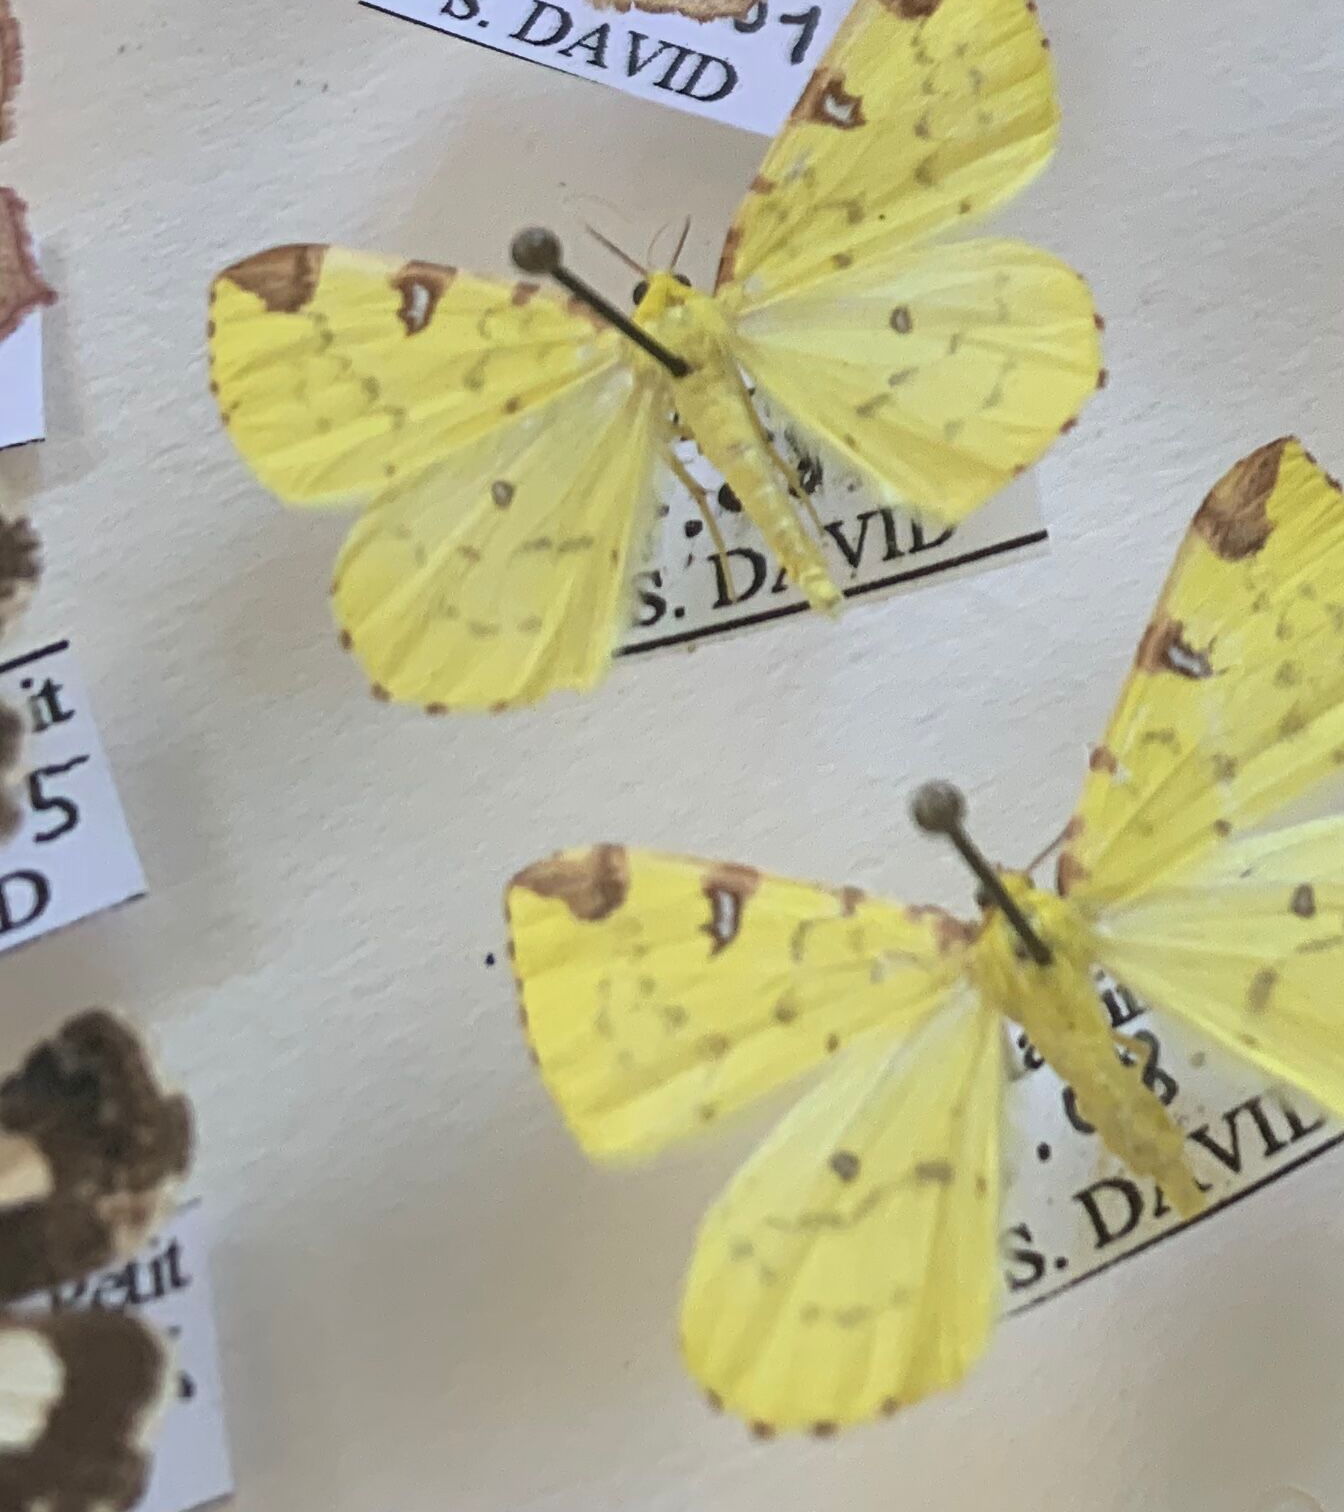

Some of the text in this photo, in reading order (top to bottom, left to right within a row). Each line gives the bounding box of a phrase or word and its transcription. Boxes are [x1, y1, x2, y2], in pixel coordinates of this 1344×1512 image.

[634, 503, 955, 627] S. DVID
[1006, 1221, 1070, 1291] S.
